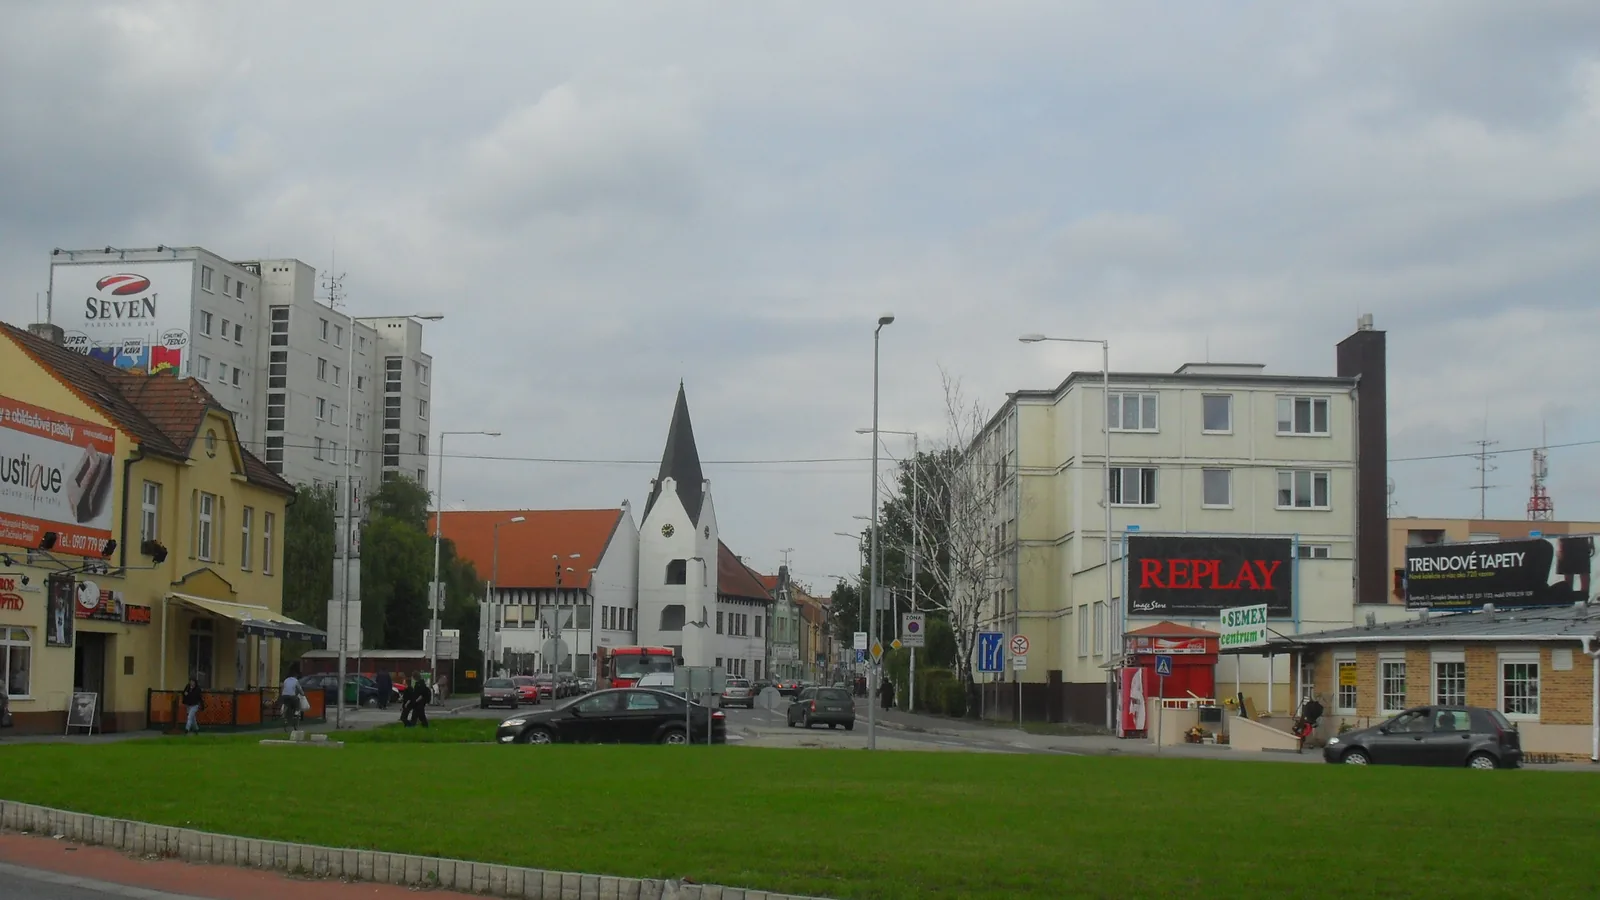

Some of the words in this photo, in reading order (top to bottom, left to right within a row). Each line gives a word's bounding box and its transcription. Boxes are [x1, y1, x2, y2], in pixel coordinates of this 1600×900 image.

[85, 293, 158, 319] SEVEN
[64, 336, 87, 345] UPER
[1409, 551, 1477, 572] TRENDOVÉ
[1479, 551, 1526, 569] TAPETY
[1139, 558, 1282, 590] REPLAY
[1227, 607, 1267, 627] SEMEX
[1221, 629, 1258, 645] centrum
